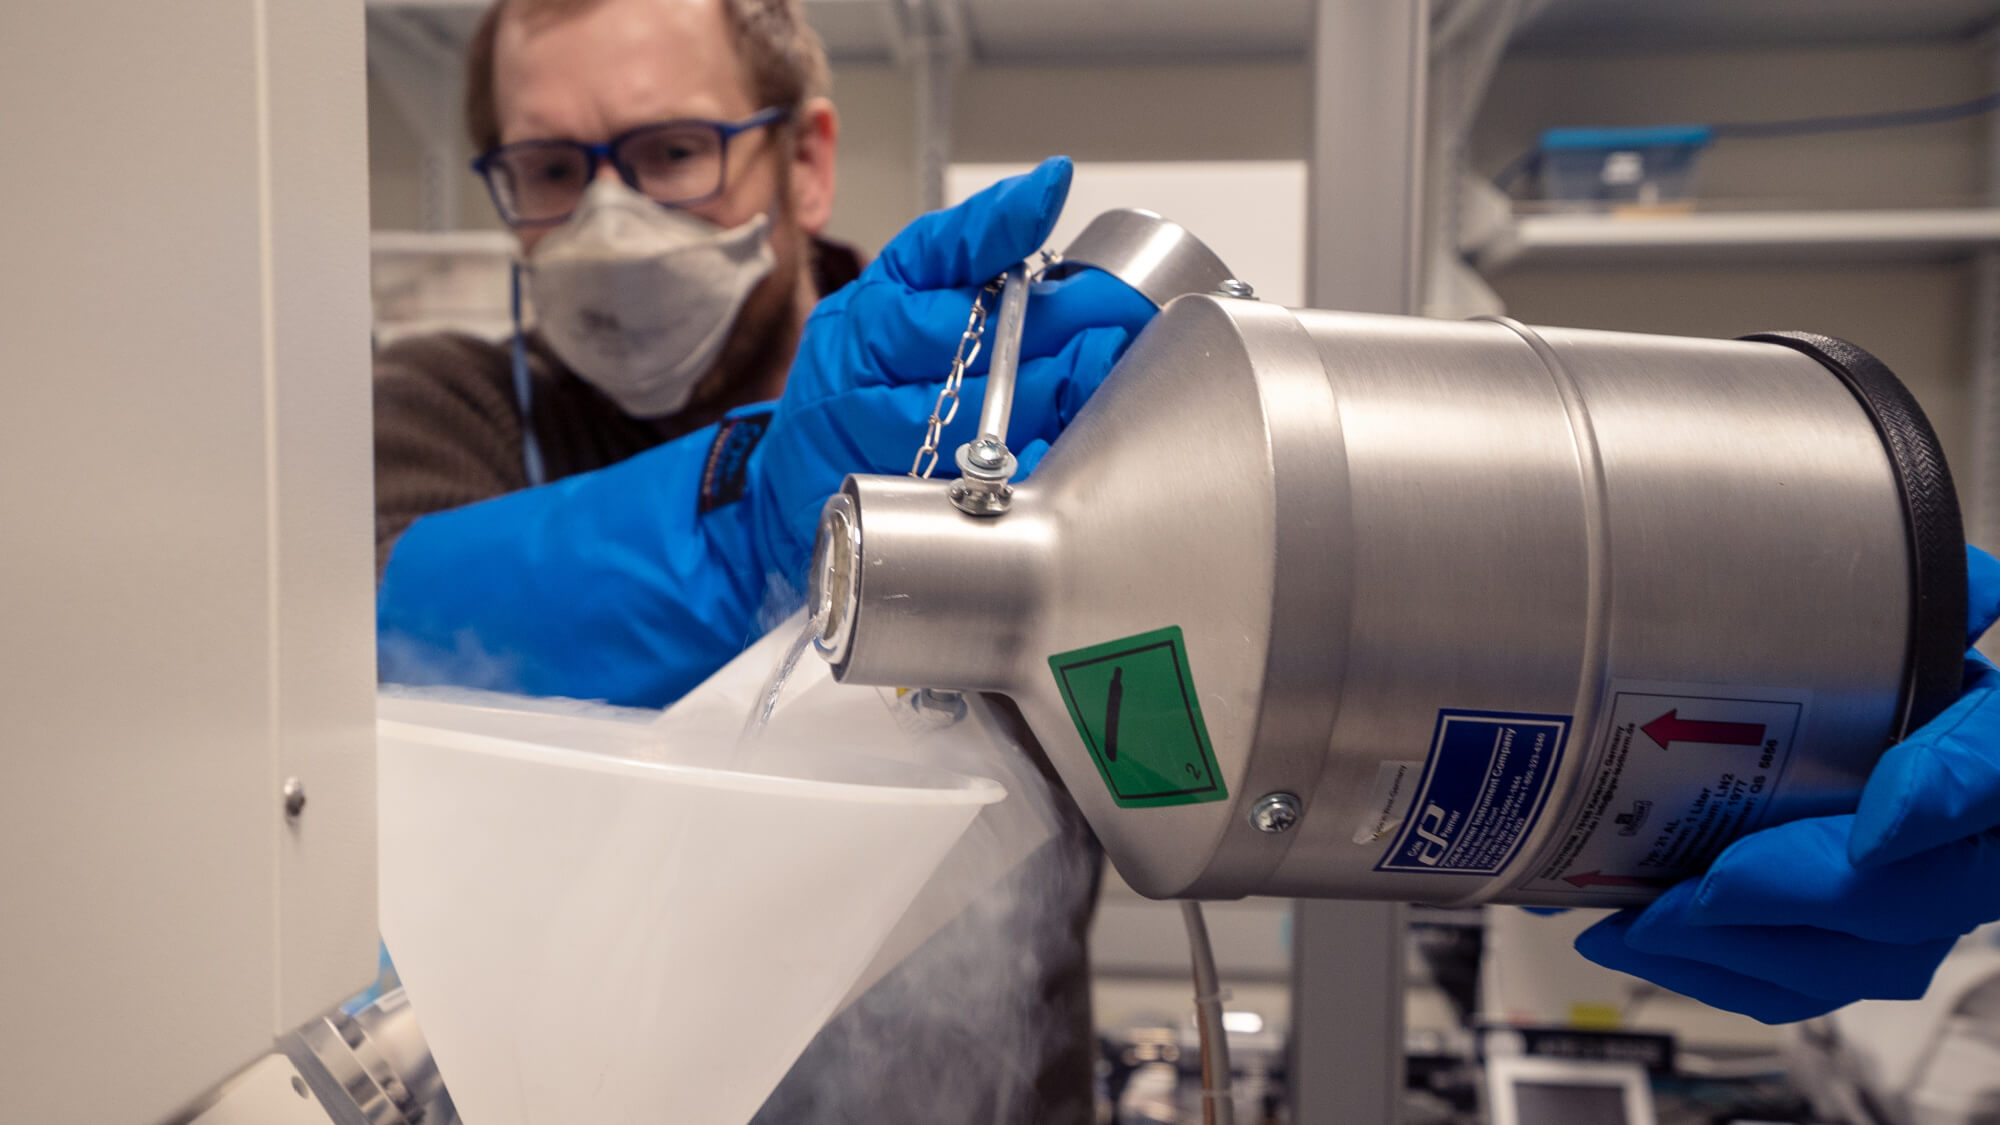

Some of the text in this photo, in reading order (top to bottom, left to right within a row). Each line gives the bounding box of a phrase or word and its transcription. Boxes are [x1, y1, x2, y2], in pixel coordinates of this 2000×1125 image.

[1603, 726, 1624, 766] Germany
[1185, 762, 1201, 780] 2
[1470, 777, 1501, 825] Instrument
[1490, 727, 1517, 776] Company
[1713, 773, 1734, 797] LN2
[1726, 779, 1747, 805] 1977
[1689, 788, 1712, 813] Liter
[1662, 818, 1680, 833] AL
